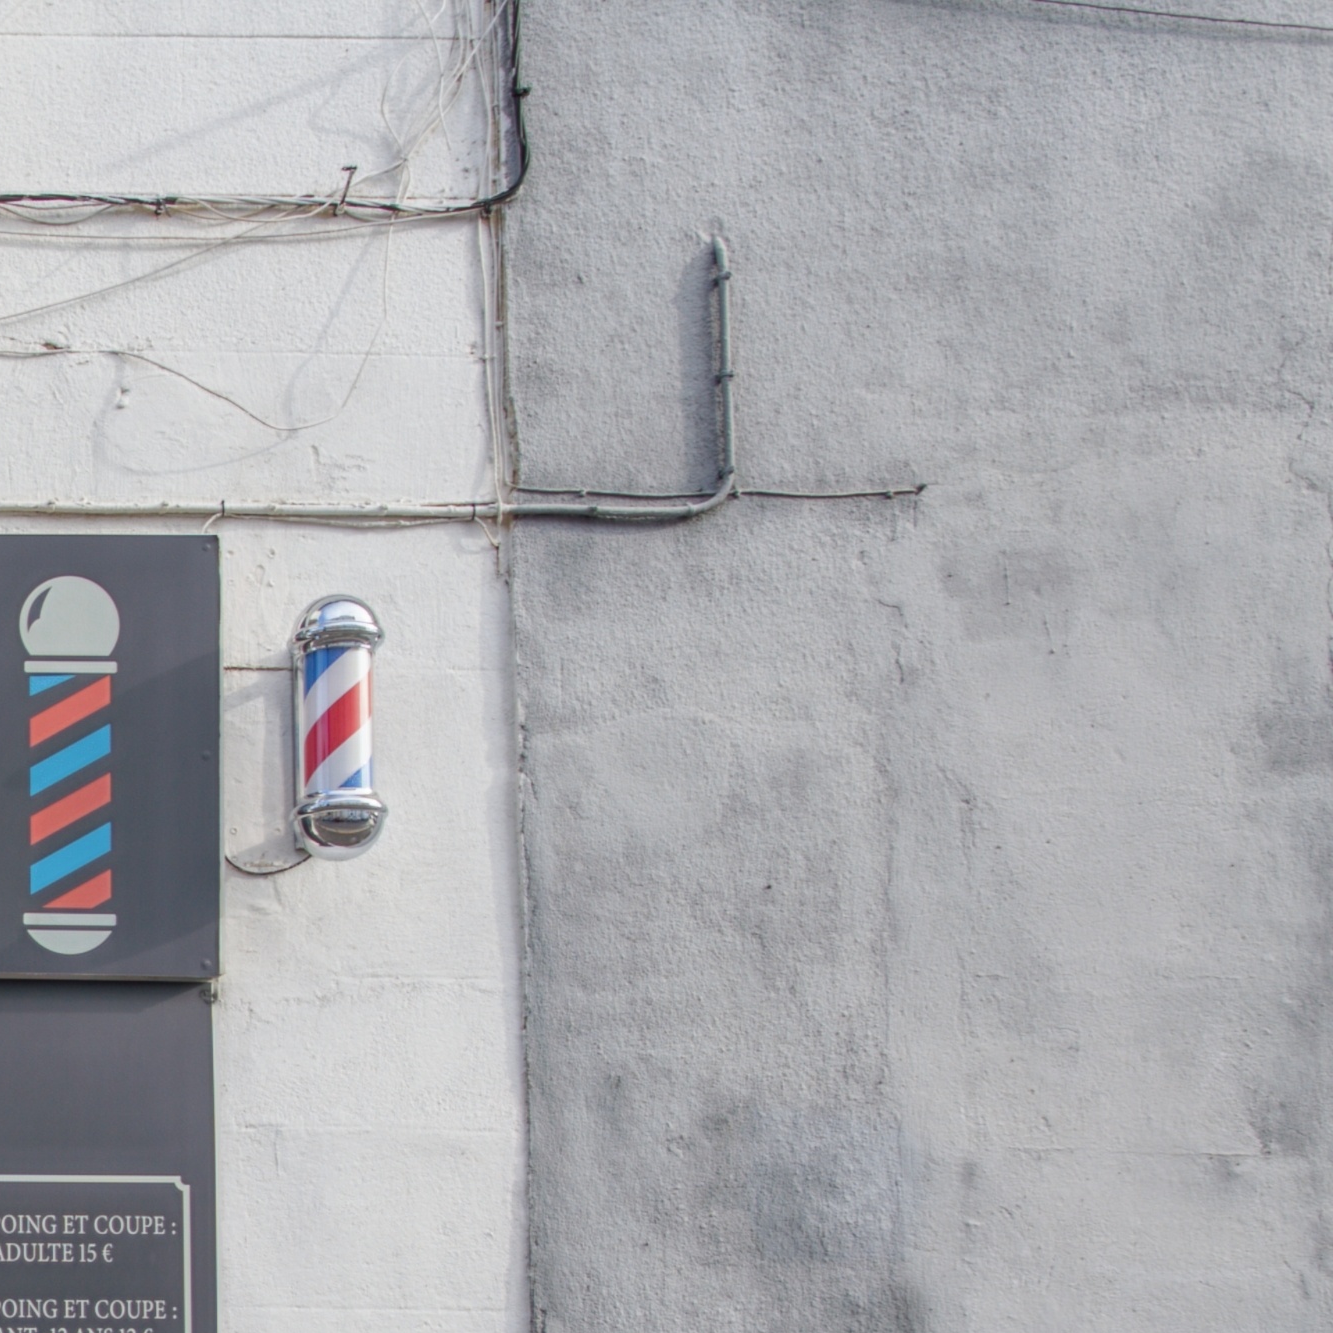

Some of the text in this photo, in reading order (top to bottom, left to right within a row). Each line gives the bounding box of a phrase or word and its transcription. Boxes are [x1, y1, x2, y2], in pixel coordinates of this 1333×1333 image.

[63, 1214, 89, 1235] ET
[94, 1215, 166, 1235] COUPE
[79, 1243, 97, 1262] 15
[63, 1300, 89, 1319] ET
[94, 1300, 167, 1319] COUPE
